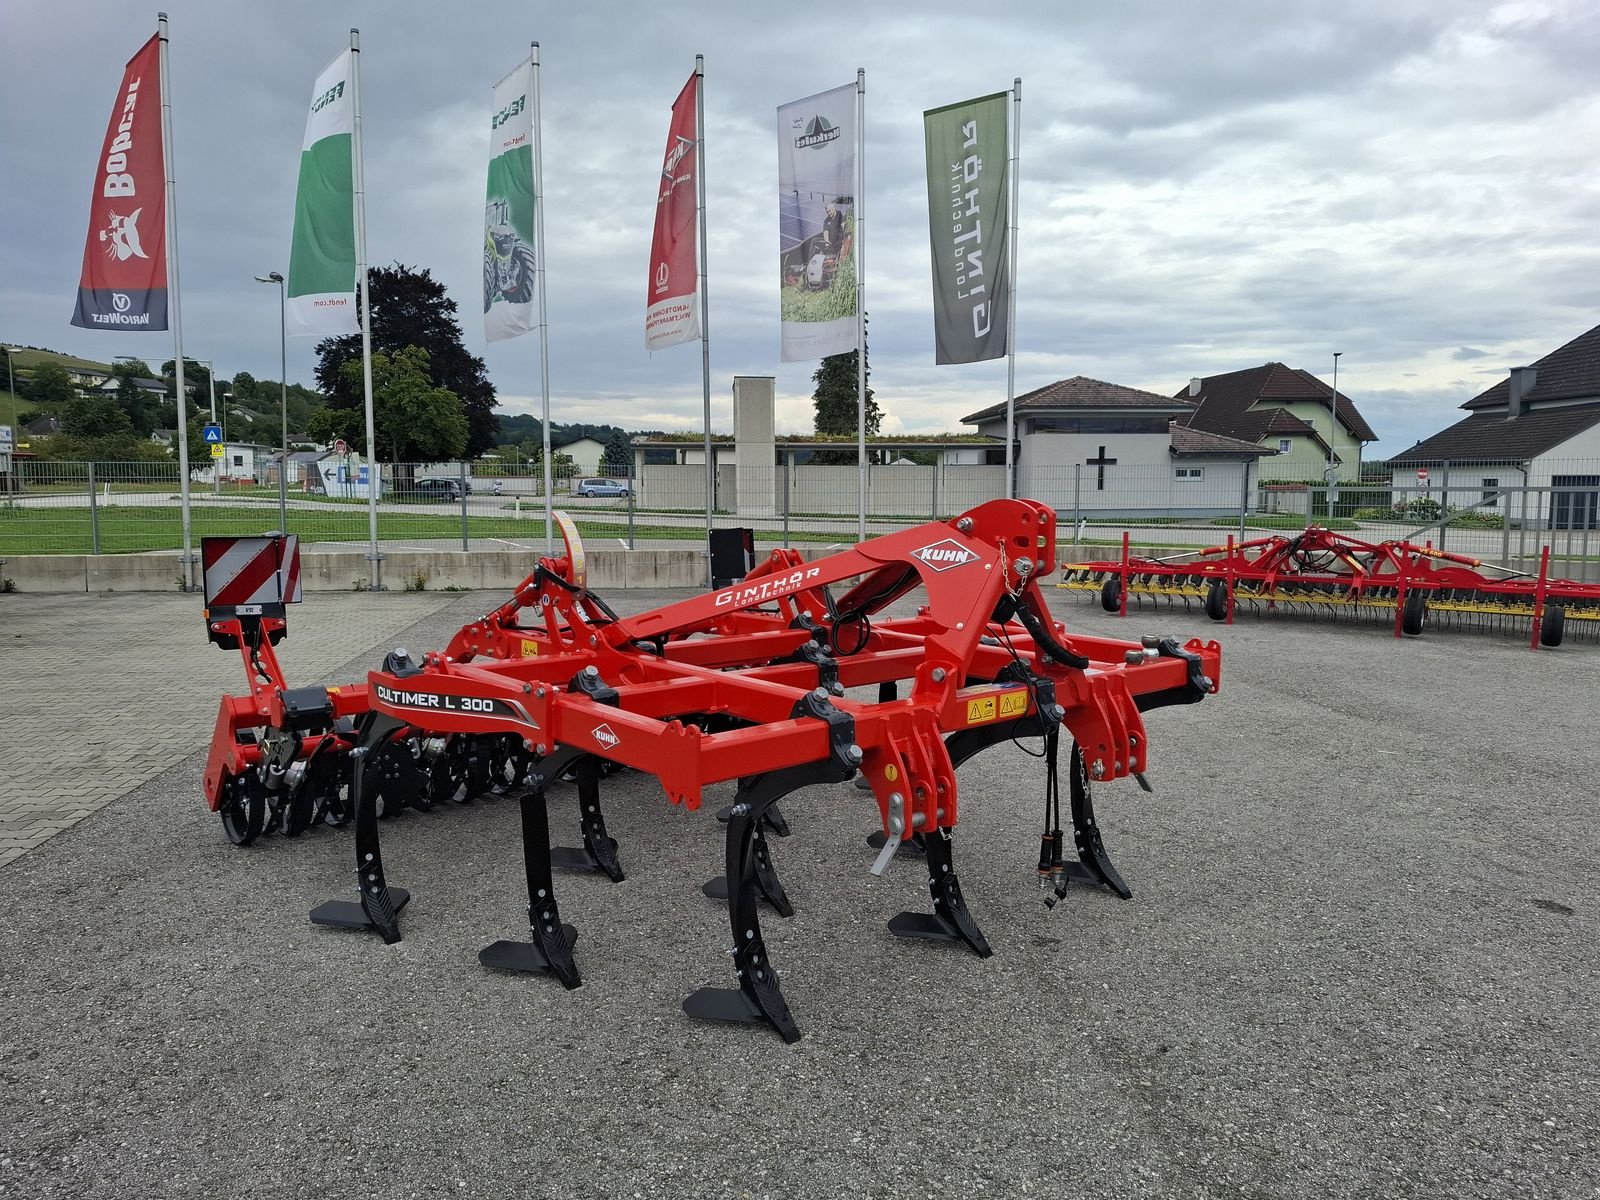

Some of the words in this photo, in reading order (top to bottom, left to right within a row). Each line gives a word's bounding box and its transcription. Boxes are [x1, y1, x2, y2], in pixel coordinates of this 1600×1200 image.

[920, 548, 969, 563] KUHN
[1419, 547, 1428, 555] VS
[1429, 550, 1442, 558] 600
[576, 575, 583, 585] 1
[377, 686, 440, 708] CULTIMER
[445, 696, 456, 709] L
[461, 698, 494, 712] 300
[596, 729, 615, 745] KUHN
